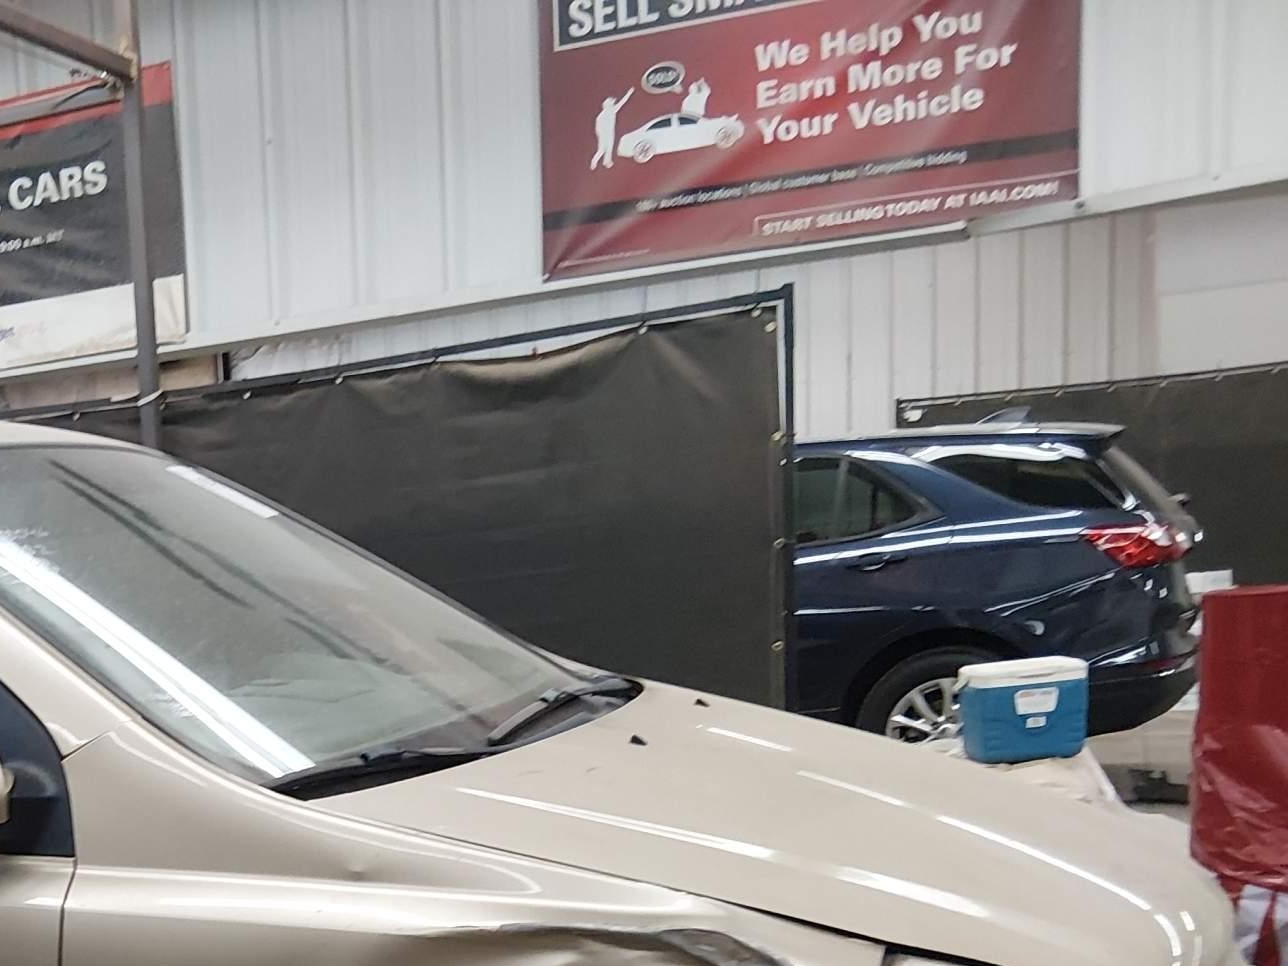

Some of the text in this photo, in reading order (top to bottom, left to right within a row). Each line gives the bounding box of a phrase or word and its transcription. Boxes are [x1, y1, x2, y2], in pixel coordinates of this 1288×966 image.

[568, 0, 660, 38] SELL
[754, 10, 983, 72] We Help You
[756, 42, 1018, 109] Earn More For
[756, 85, 985, 145] Your Vehicle
[8, 160, 109, 211] CARS
[762, 215, 814, 236] START
[815, 204, 884, 228] SELLING
[884, 195, 943, 218] TODAY
[944, 193, 968, 210] AT
